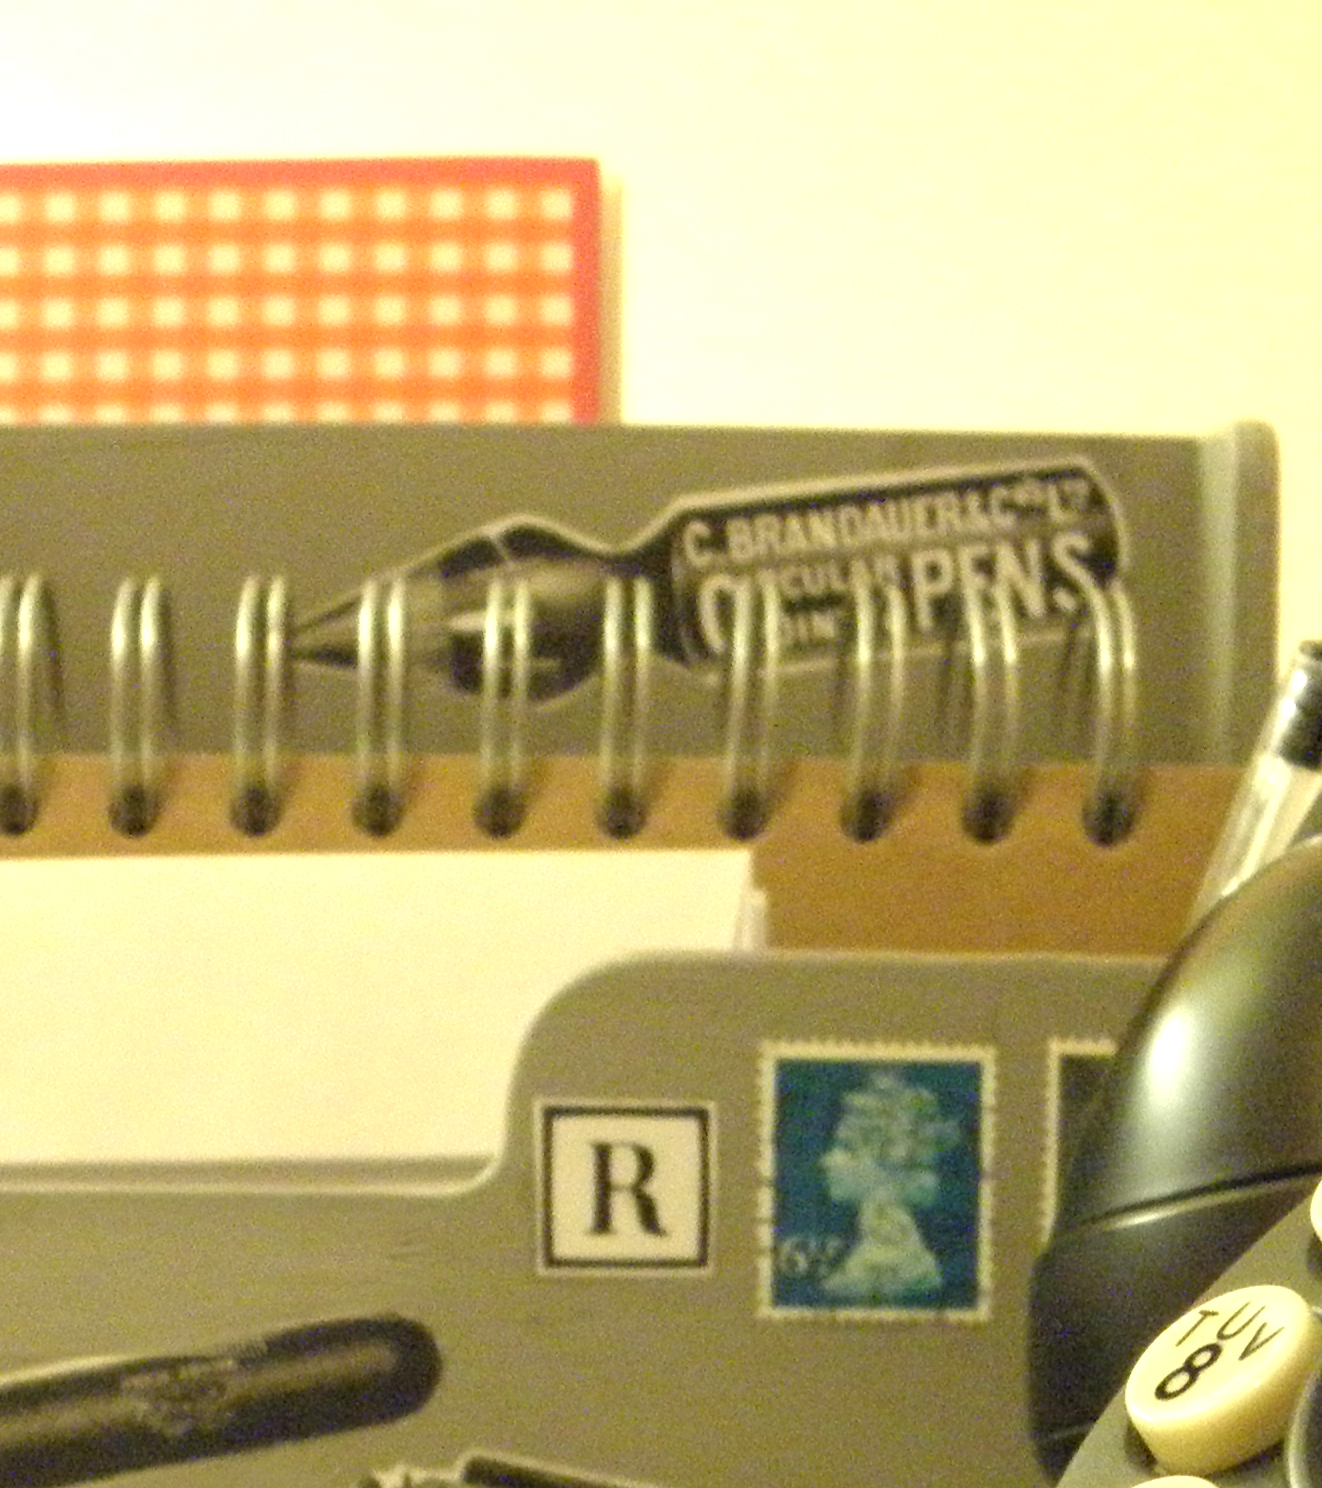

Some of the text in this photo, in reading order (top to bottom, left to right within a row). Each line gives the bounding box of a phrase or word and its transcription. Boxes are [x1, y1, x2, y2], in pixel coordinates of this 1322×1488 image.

[587, 1140, 668, 1238] R
[1175, 1301, 1285, 1362] TUV
[1154, 1343, 1223, 1402] 8
